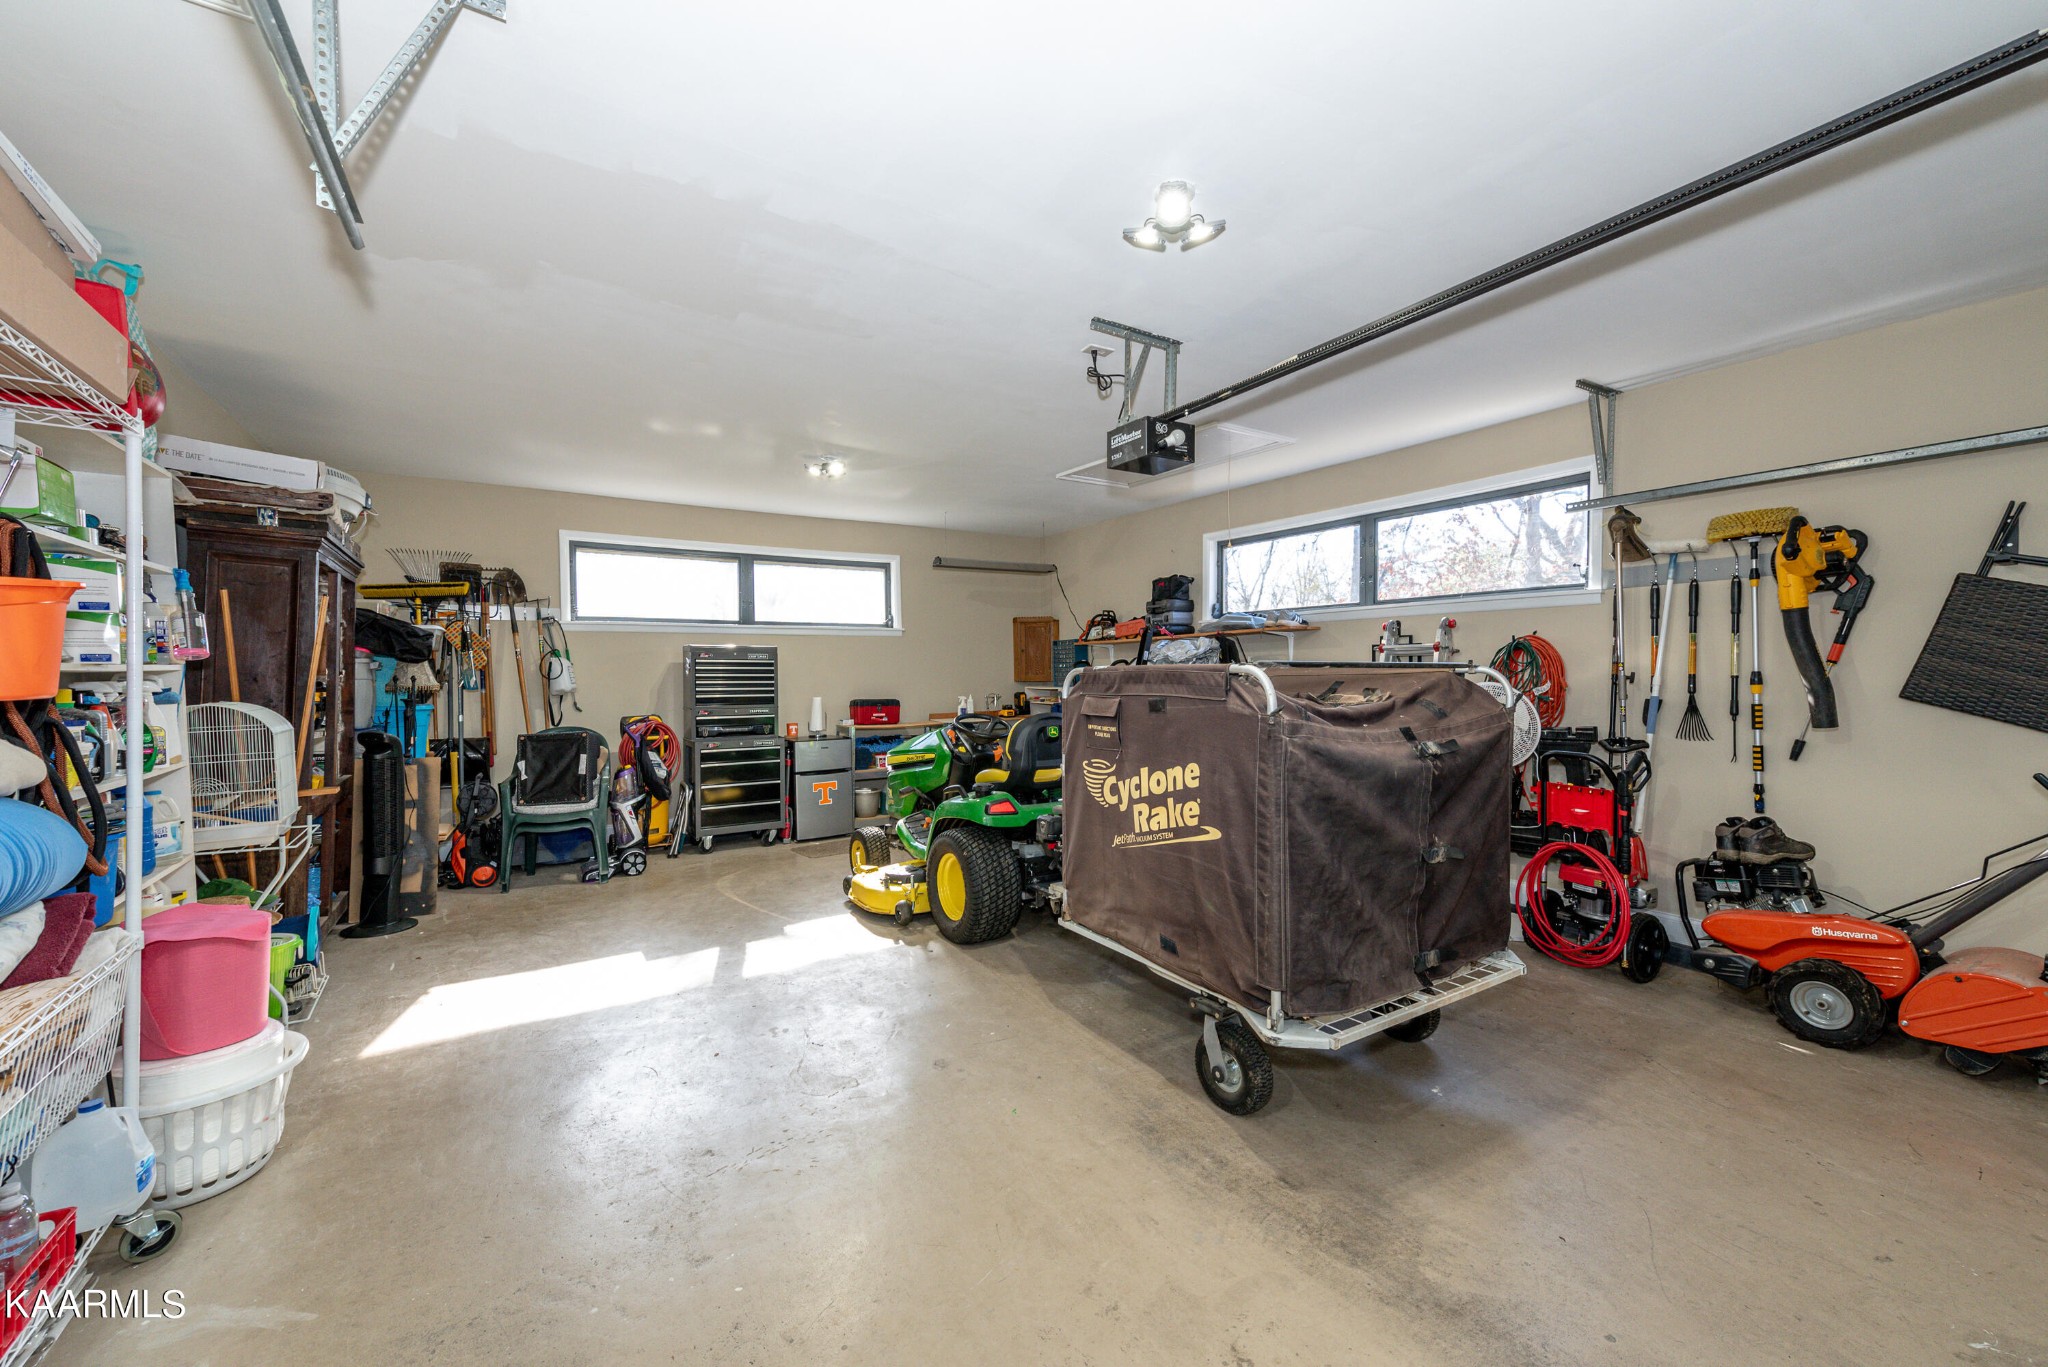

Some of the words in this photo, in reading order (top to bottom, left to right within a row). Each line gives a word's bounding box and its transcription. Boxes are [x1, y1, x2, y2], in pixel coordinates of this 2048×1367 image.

[156, 447, 169, 456] AVE
[171, 449, 184, 458] THE
[789, 725, 798, 734] T
[813, 781, 837, 805] T
[1103, 762, 1200, 812] Cyclone
[1133, 798, 1200, 833] Rake
[1153, 831, 1174, 841] SYSTEM
[1823, 928, 1878, 940] Husqvarna
